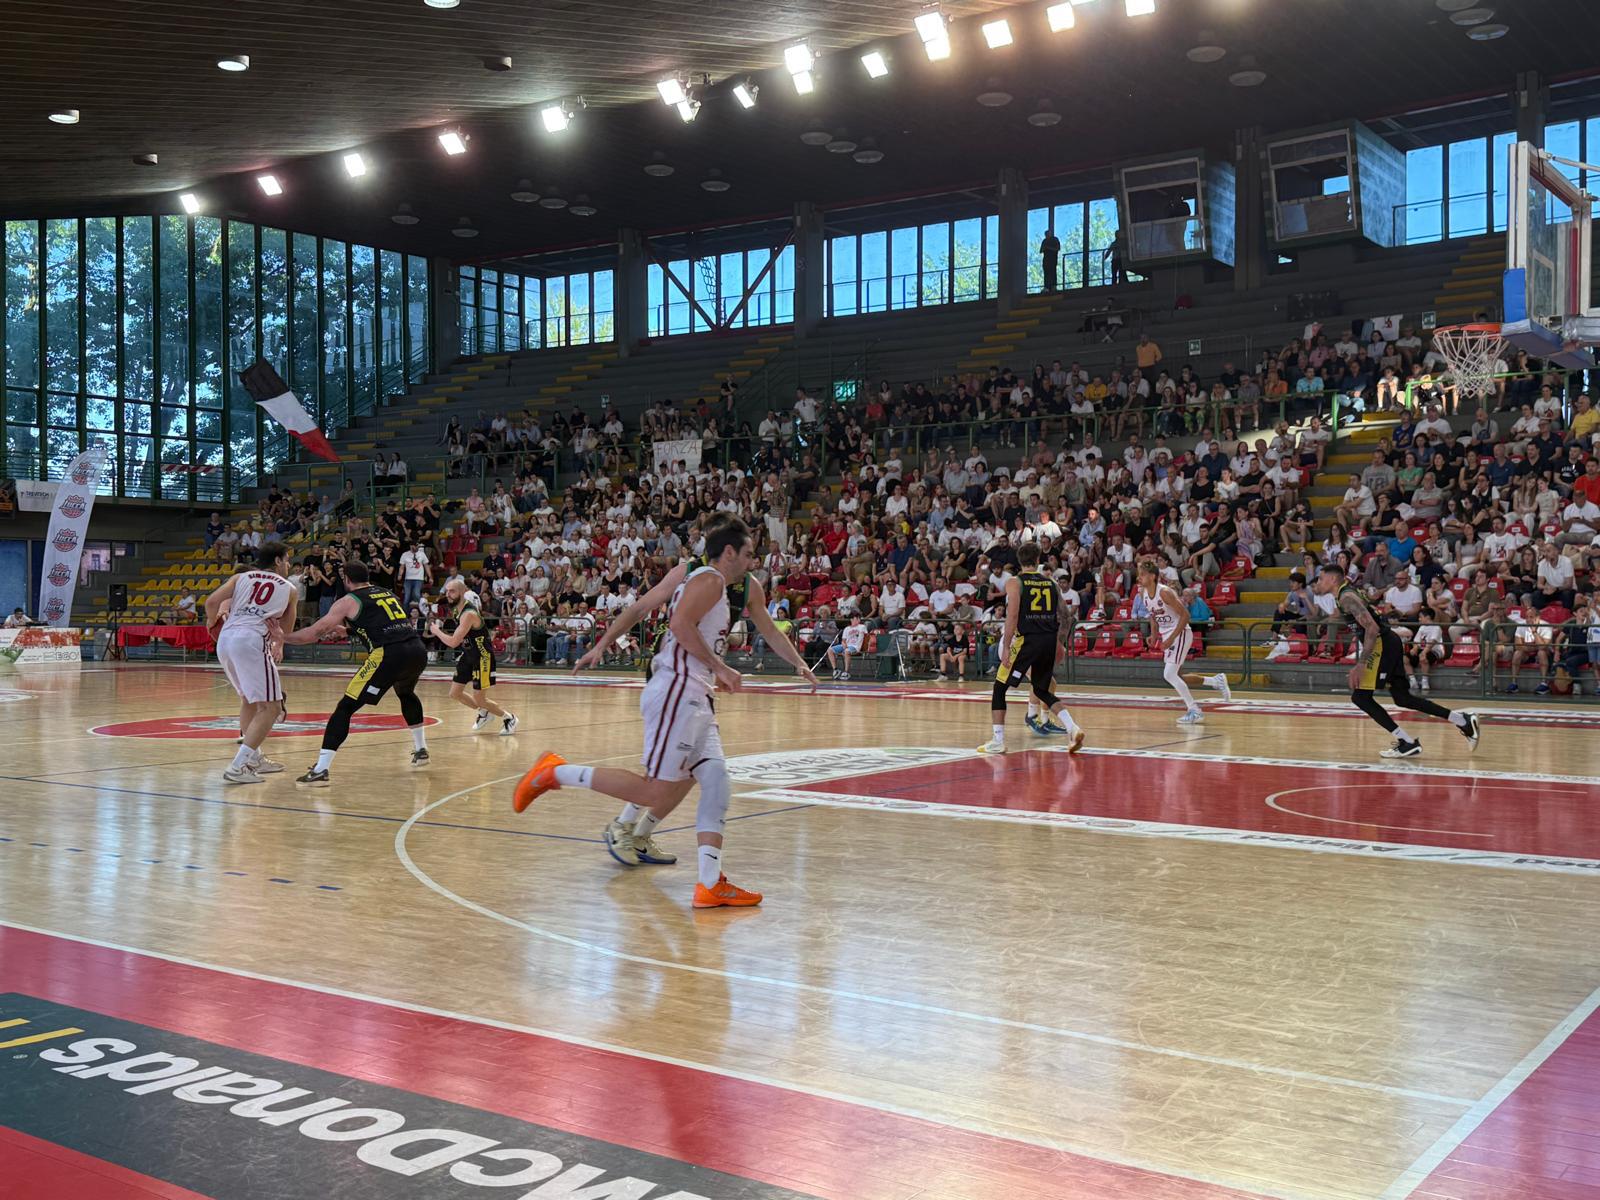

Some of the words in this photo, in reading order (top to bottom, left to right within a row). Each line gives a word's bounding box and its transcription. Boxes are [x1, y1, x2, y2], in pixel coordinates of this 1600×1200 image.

[656, 441, 698, 456] FORZA
[59, 500, 87, 511] LUCCA
[52, 533, 78, 544] LUCCA
[47, 568, 72, 579] LUCCA
[248, 581, 275, 606] 10
[1030, 587, 1052, 611] 21
[376, 597, 407, 620] 13
[39, 1037, 710, 1200] McDonald's
